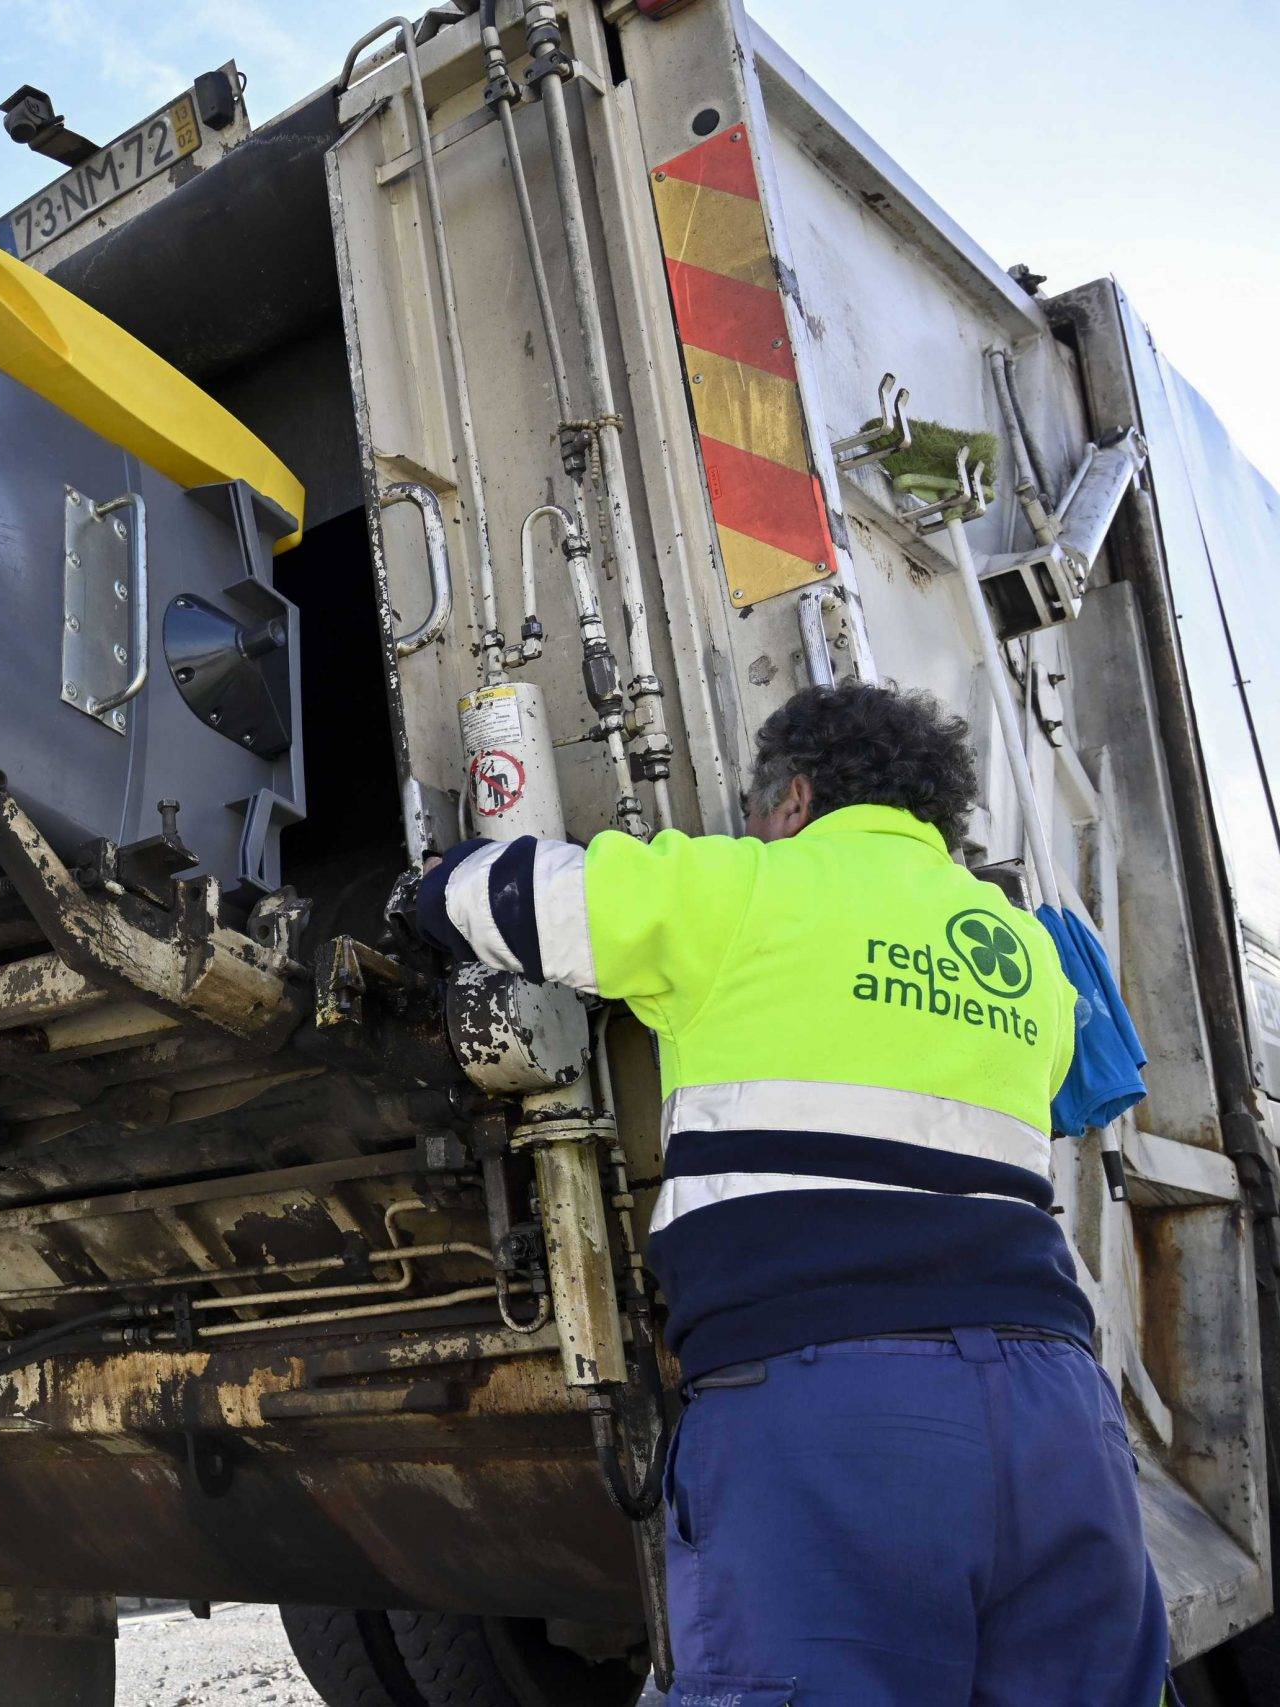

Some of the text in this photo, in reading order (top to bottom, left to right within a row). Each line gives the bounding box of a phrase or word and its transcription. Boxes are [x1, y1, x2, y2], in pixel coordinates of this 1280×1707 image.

[177, 129, 193, 148] 02
[867, 938, 960, 982] rede
[852, 972, 1038, 1046] ambiente
